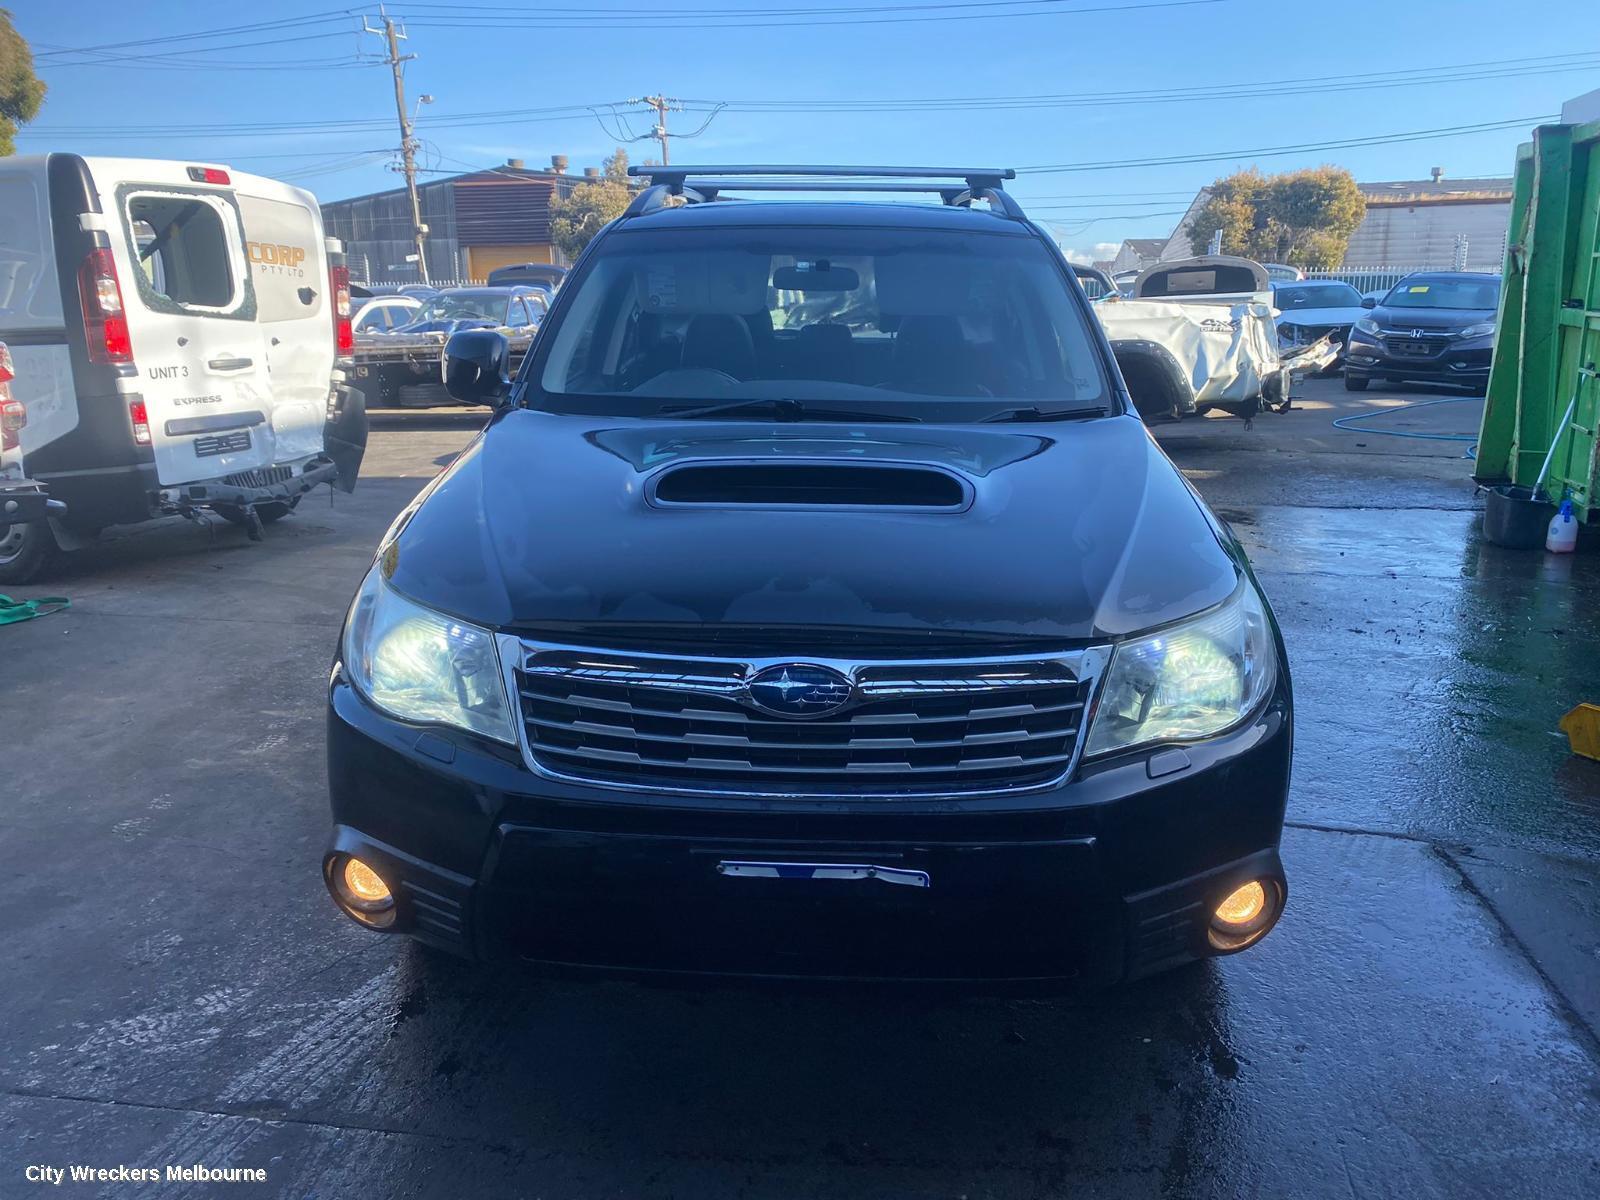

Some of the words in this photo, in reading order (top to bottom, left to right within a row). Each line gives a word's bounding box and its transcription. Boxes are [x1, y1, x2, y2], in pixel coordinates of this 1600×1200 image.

[247, 241, 305, 267] CORP
[261, 264, 283, 275] PTY
[288, 268, 304, 278] LTD
[148, 366, 179, 379] UNIT
[181, 365, 189, 377] 3
[173, 395, 222, 406] EXPRESS
